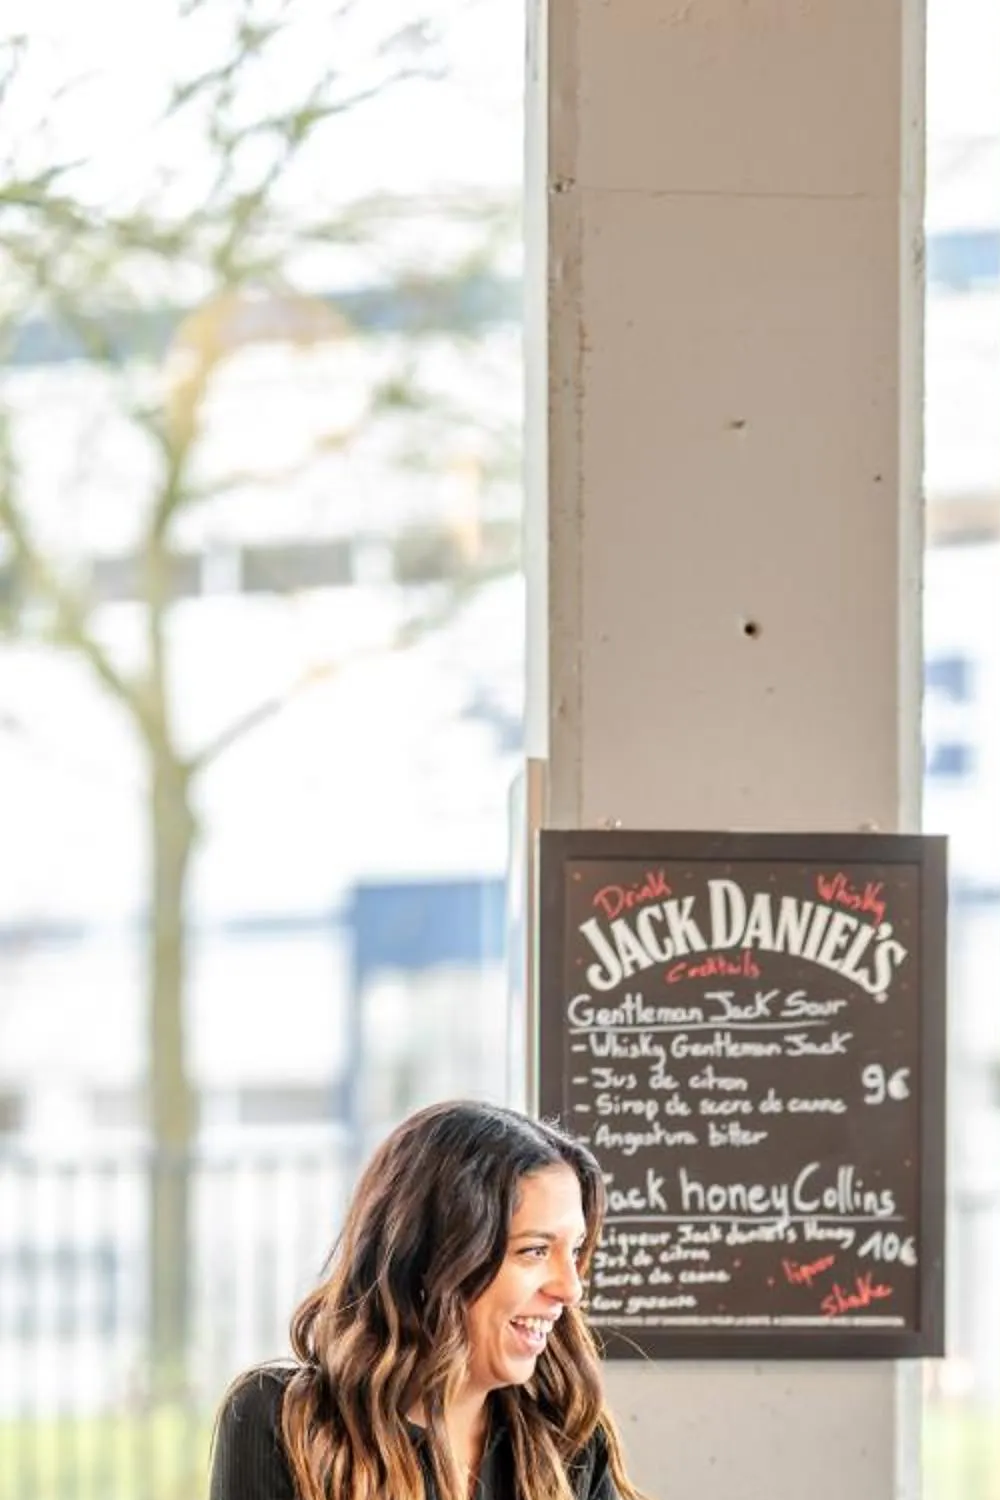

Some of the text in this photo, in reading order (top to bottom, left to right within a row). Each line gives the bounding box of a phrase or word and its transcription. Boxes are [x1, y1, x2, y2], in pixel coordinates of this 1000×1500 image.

[579, 878, 909, 1004] JACK DANIEL'S
[567, 993, 702, 1027] Gentleman
[780, 990, 847, 1017] Sour
[671, 1032, 782, 1058] Gentleman
[591, 1067, 637, 1090] Jus
[649, 1066, 680, 1090] de
[688, 1063, 749, 1091] citron
[595, 1093, 658, 1121] Sirop
[664, 1093, 692, 1117] de
[699, 1098, 753, 1116] sucre
[758, 1087, 783, 1114] de
[786, 1096, 848, 1115] canne
[708, 1120, 769, 1147] bitter
[679, 1166, 790, 1226] honey
[793, 1161, 896, 1217] Collins
[648, 1266, 674, 1285] de
